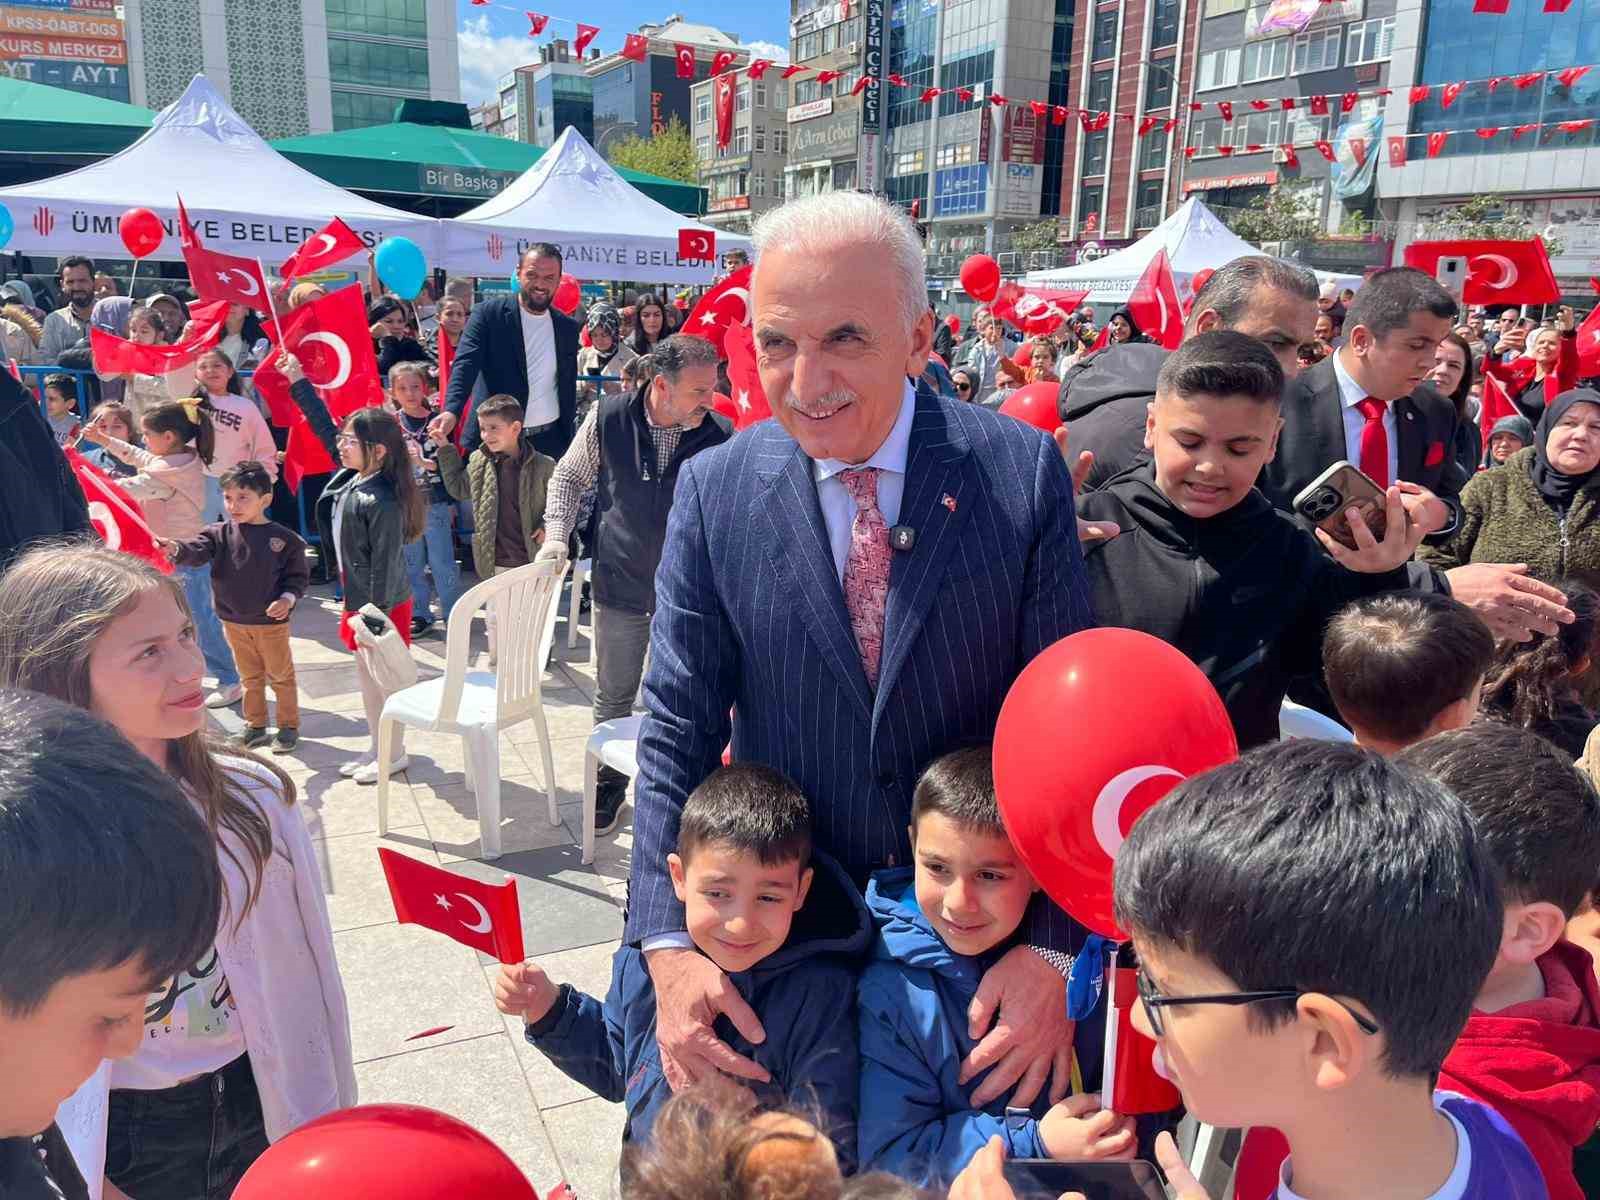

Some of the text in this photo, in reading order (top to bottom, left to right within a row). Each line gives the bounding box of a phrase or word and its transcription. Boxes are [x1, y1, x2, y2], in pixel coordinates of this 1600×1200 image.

[0, 39, 43, 54] KURS
[71, 65, 120, 84] AYT
[426, 169, 448, 185] Bir
[453, 173, 498, 191] Başka
